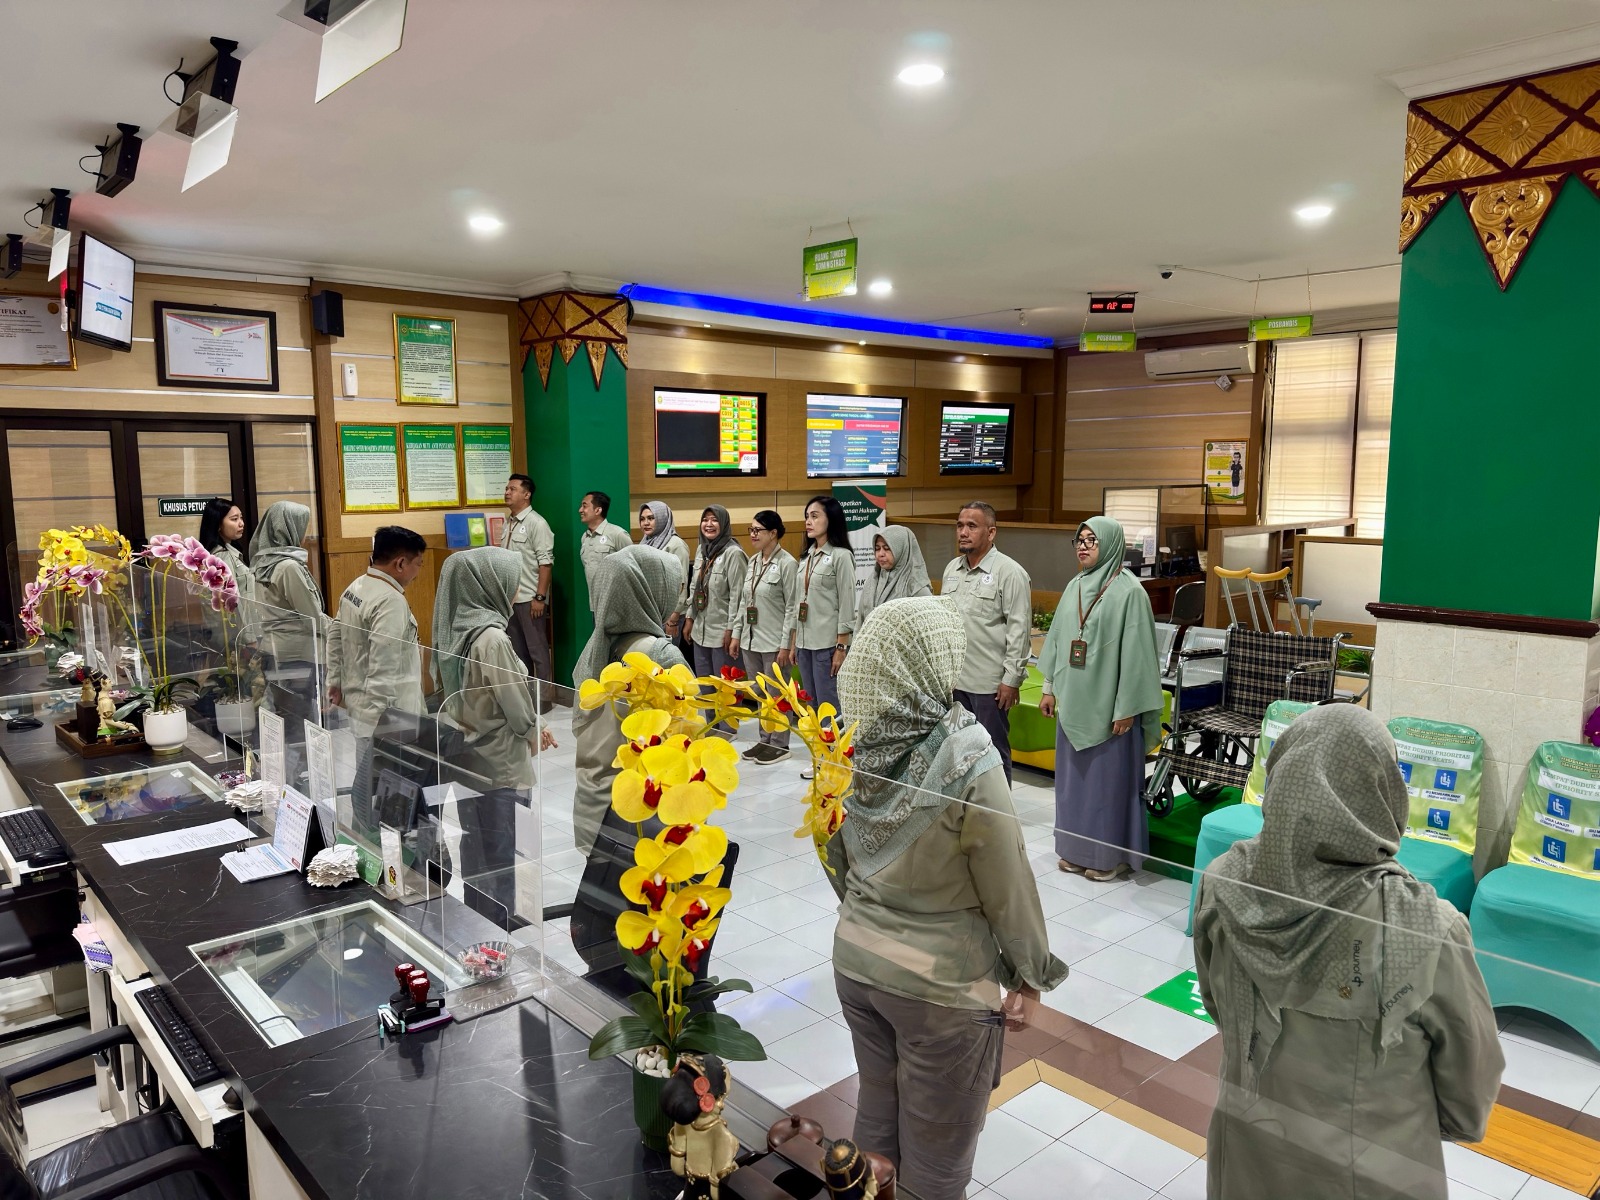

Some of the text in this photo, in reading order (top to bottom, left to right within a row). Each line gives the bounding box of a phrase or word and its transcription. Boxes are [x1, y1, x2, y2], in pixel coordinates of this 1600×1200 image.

[163, 502, 187, 512] KHUSUS
[1400, 751, 1455, 764] (PRIORITY SEATS)
[1412, 745, 1434, 754] DUDUK
[1435, 751, 1471, 759] PRIORITAS
[1543, 770, 1596, 789] TEMPAT DUDUK
[1555, 783, 1593, 796] (PRIORITY
[1555, 820, 1570, 828] LANJUT
[1353, 940, 1362, 976] journey
[1385, 983, 1414, 1011] journey
